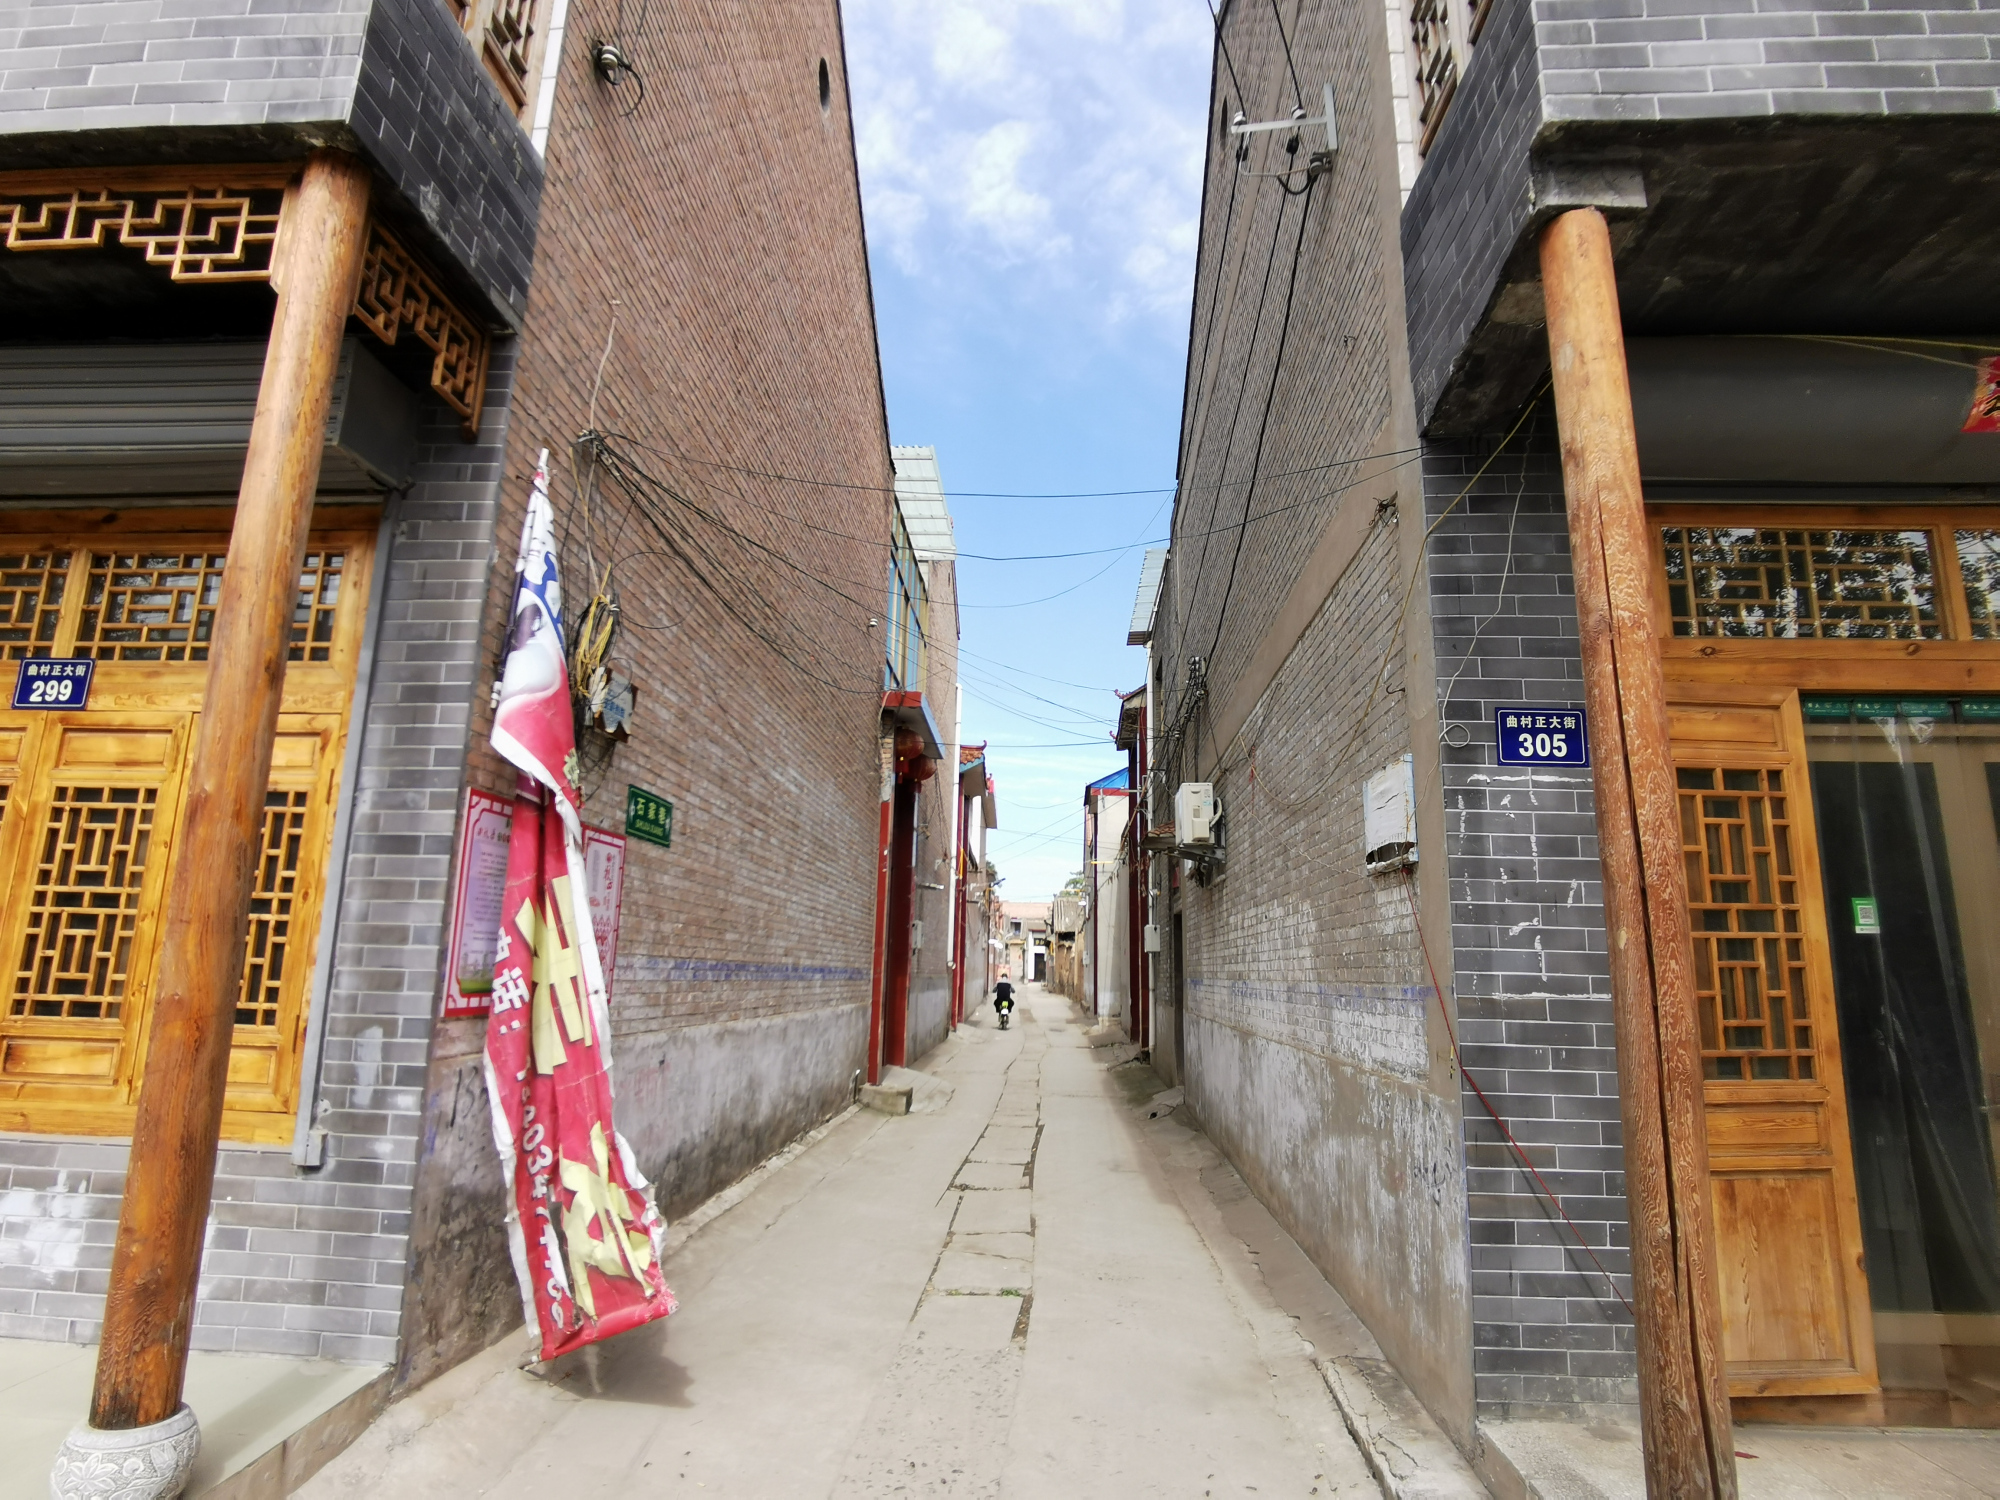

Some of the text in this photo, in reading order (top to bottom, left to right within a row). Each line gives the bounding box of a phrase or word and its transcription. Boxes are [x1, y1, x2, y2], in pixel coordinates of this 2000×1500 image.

[28, 665, 86, 676] 曲村正大街
[30, 681, 72, 702] 299
[1506, 715, 1576, 729] 曲村正大街
[1518, 733, 1568, 757] 305
